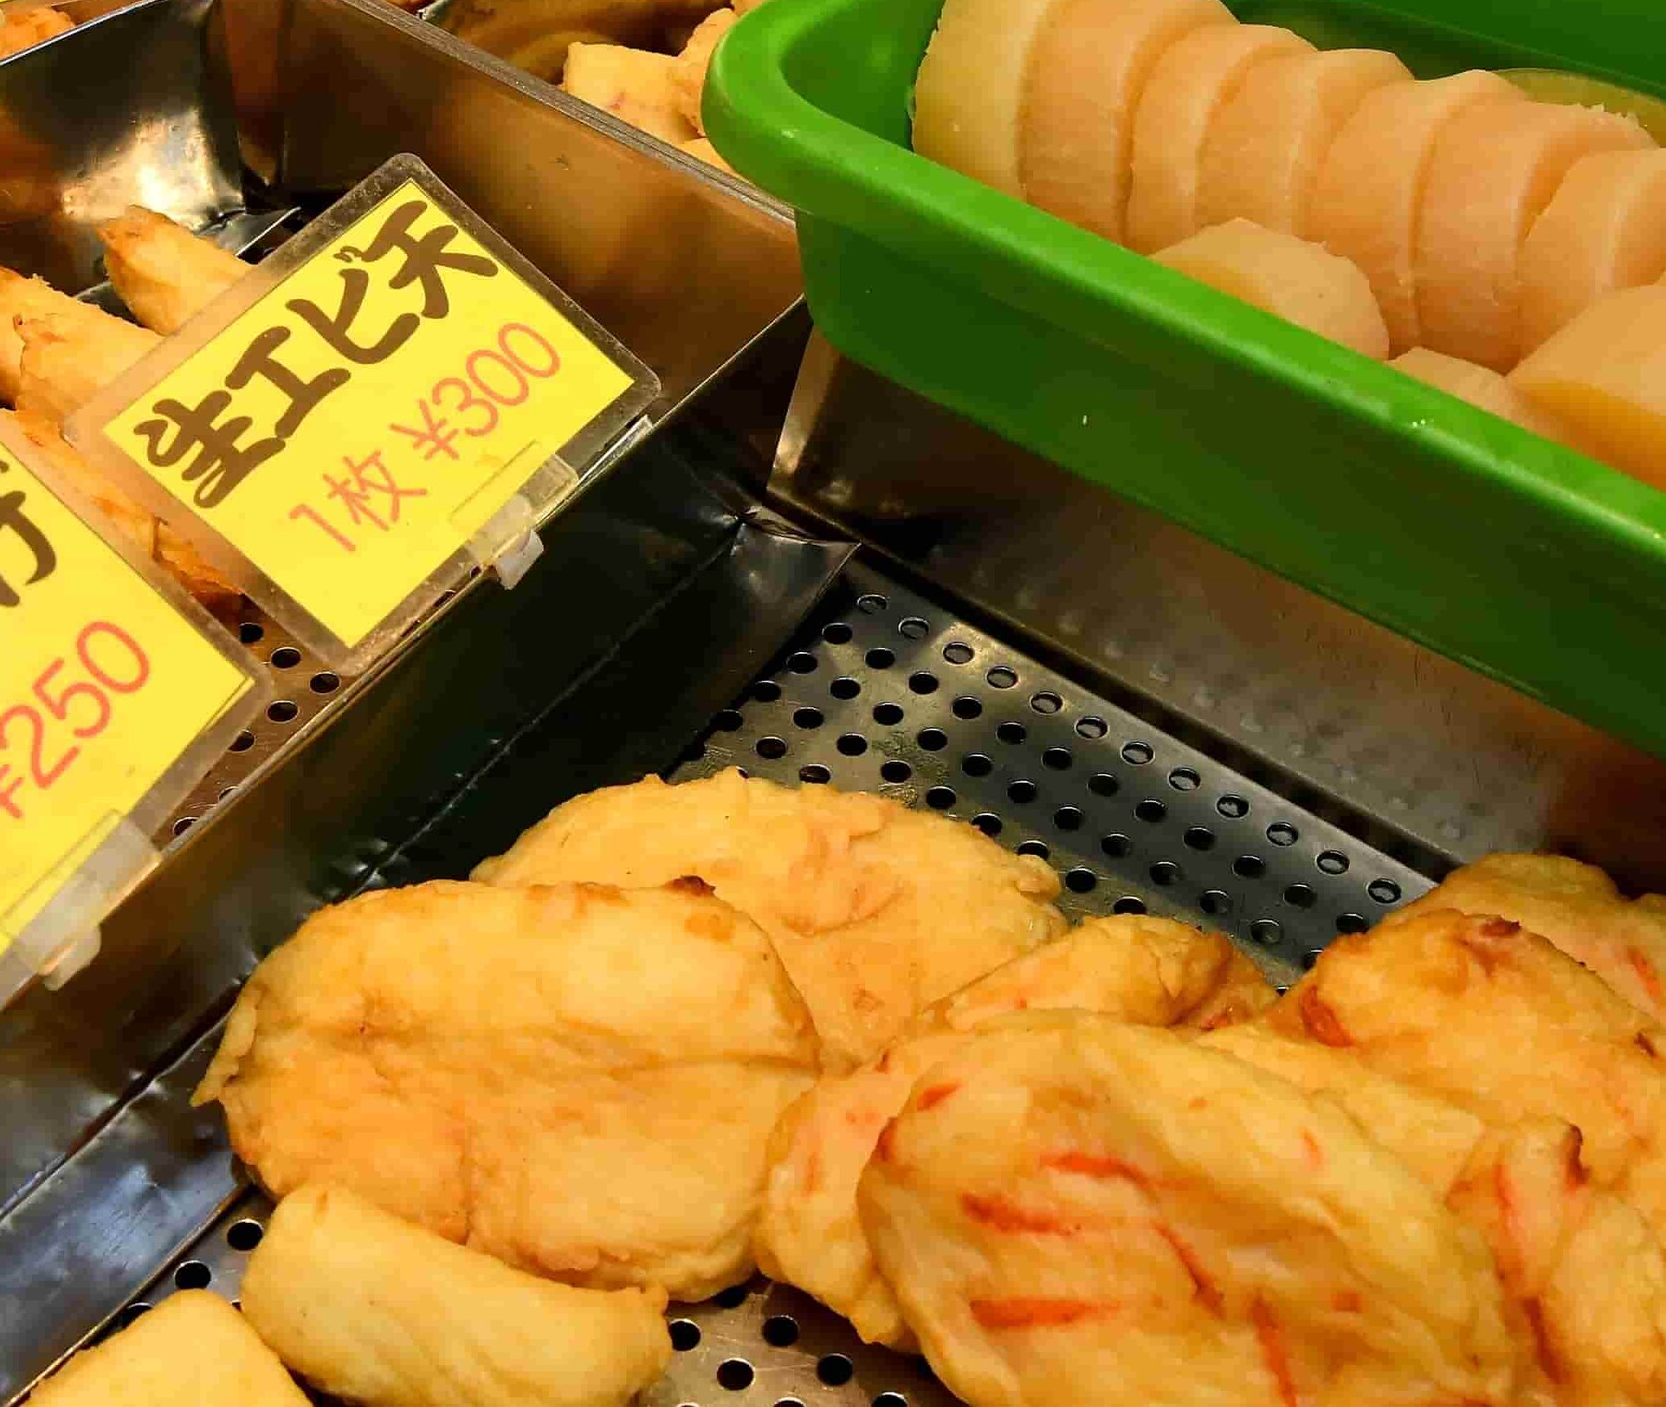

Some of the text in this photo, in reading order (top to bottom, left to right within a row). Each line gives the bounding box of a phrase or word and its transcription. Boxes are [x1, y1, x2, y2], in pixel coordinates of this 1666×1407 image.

[133, 199, 500, 509] 生エビ天
[389, 322, 561, 463] ¥300
